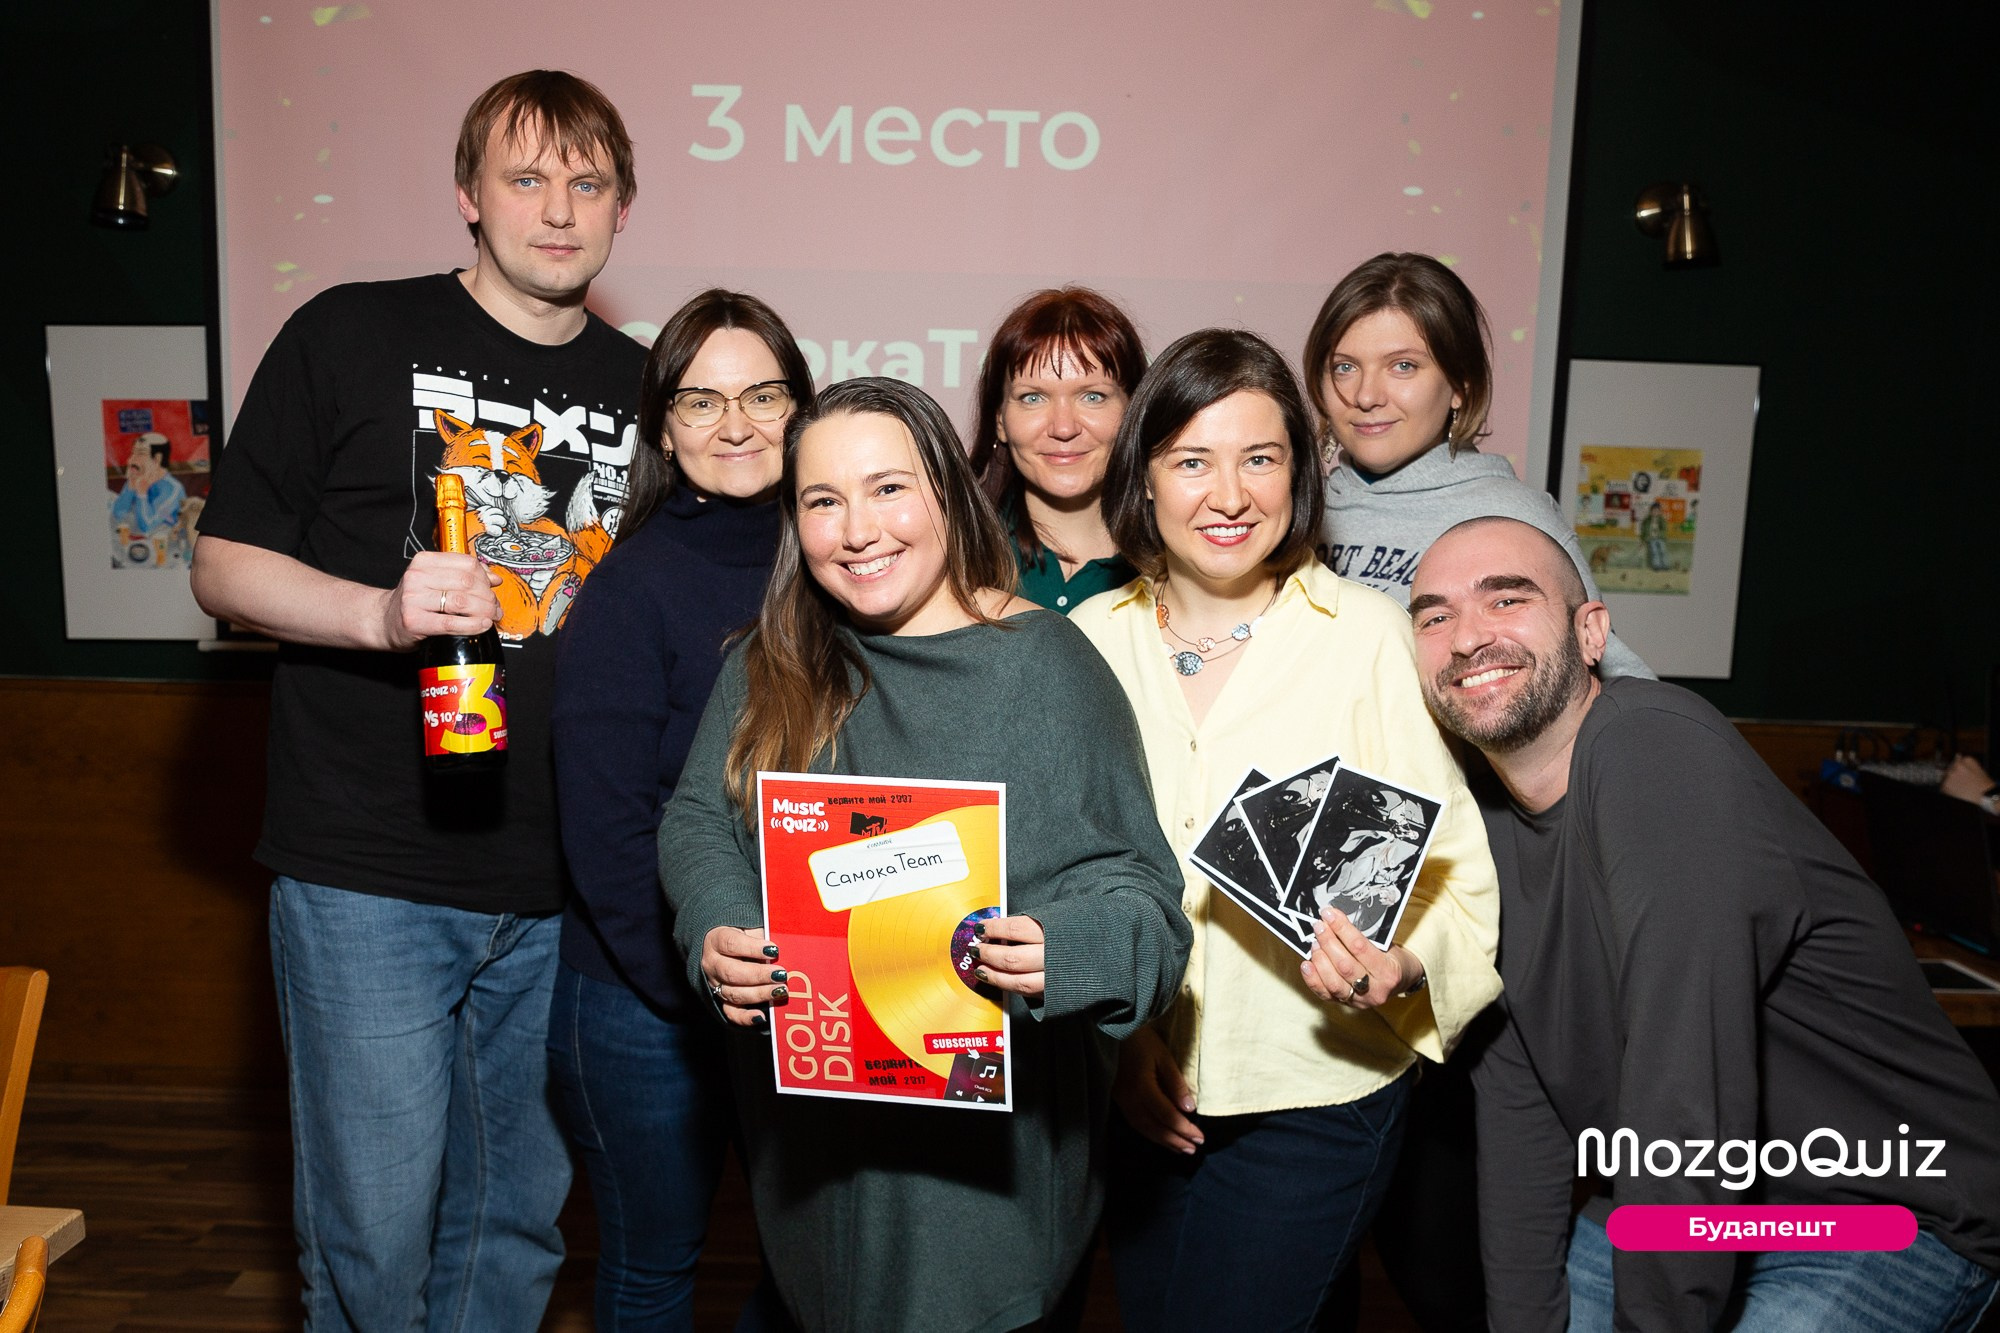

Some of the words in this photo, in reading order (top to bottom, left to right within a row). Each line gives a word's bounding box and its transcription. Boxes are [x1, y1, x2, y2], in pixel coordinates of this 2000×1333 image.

[688, 84, 745, 162] 3
[785, 104, 1101, 171] место
[412, 363, 510, 385] POWER
[542, 388, 567, 404] OF
[1359, 545, 1419, 586] BEAC
[437, 664, 502, 753] 3
[784, 970, 819, 1081] GOLD
[817, 992, 854, 1083] DISK
[932, 1037, 989, 1050] SUBSCRIBE
